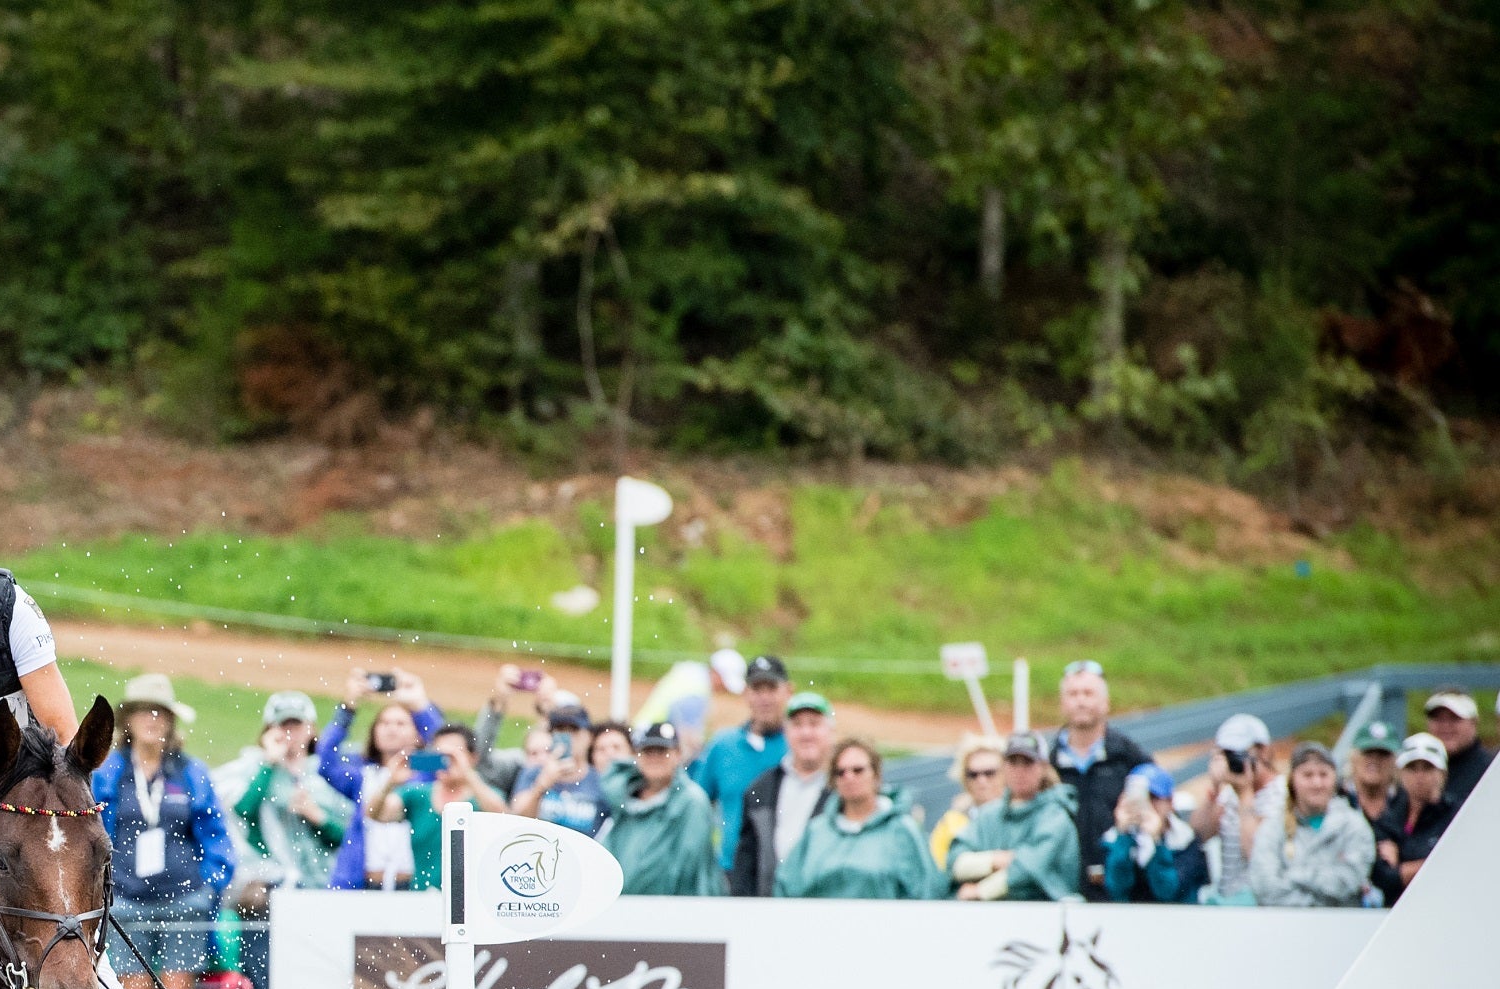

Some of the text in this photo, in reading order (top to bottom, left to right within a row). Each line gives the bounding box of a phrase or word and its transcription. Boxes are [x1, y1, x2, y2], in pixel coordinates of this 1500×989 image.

[519, 882, 536, 890] 2018
[497, 902, 560, 912] FEI WORLD
